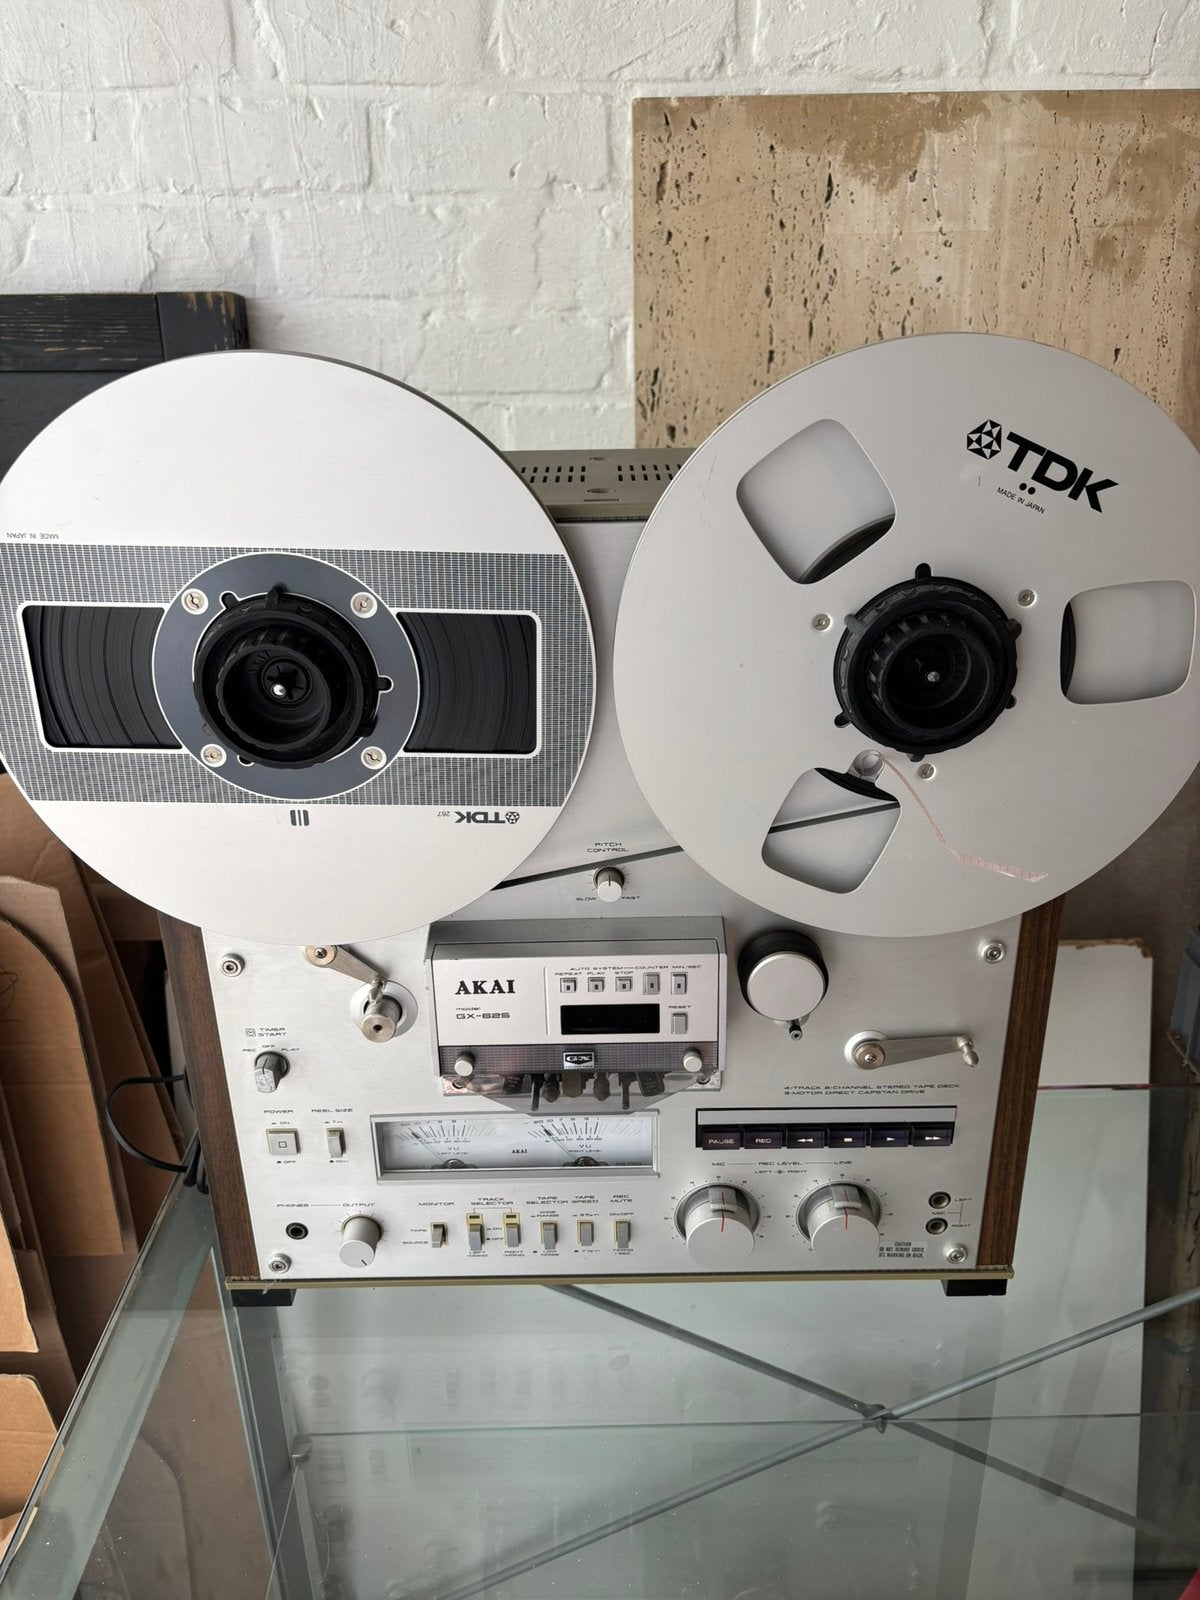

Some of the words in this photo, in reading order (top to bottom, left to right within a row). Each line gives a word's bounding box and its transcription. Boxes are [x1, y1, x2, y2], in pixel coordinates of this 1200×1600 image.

[1006, 431, 1119, 513] TDK
[997, 487, 1016, 501] MADE
[1025, 502, 1045, 514] JAPAN
[454, 811, 506, 824] TDK
[455, 979, 516, 995] AKAI
